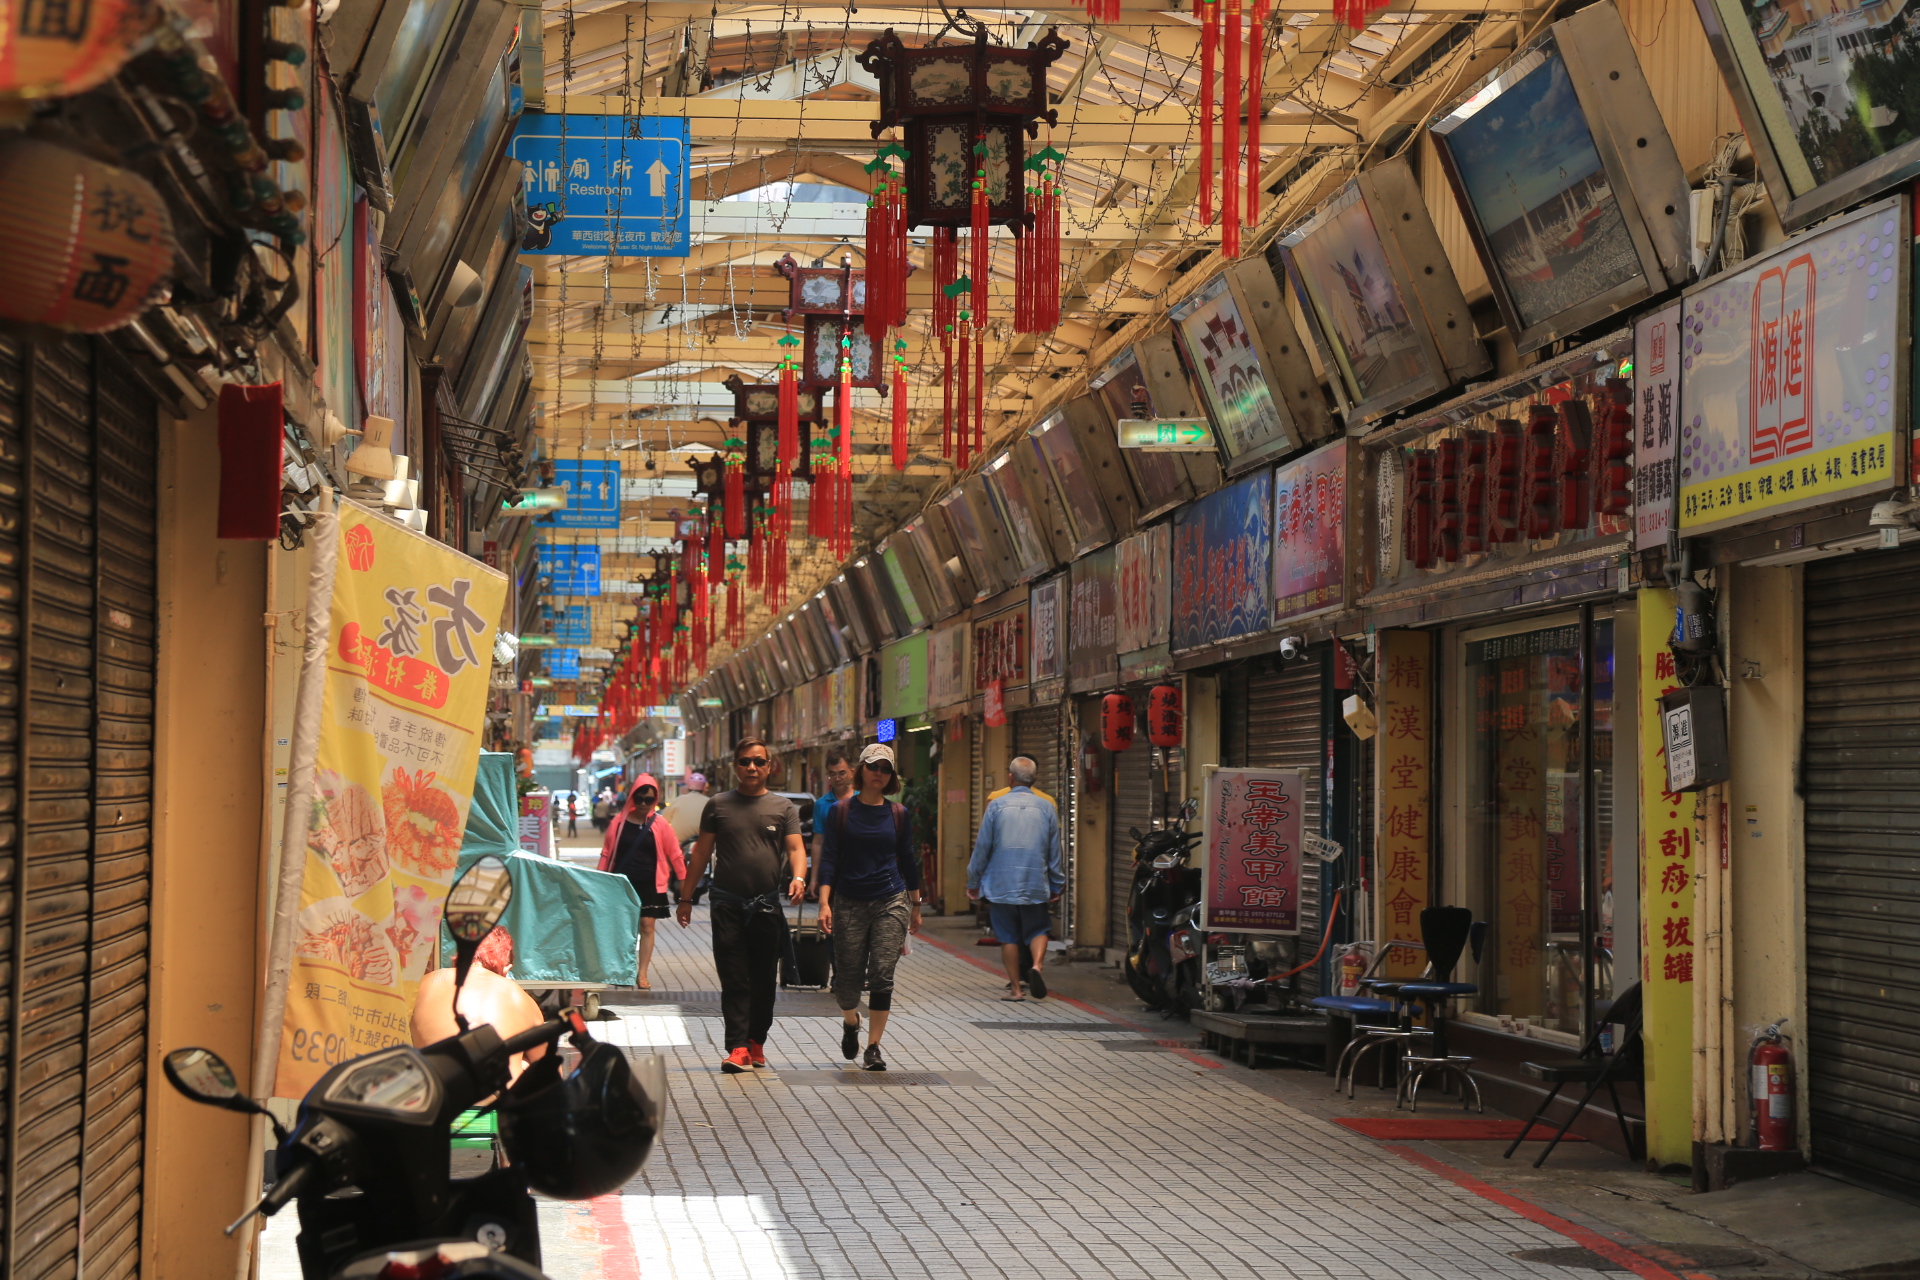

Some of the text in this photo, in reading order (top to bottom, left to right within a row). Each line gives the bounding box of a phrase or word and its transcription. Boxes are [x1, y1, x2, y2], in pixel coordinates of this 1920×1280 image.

[568, 158, 634, 180] 廁所
[569, 183, 632, 196] Restroom
[638, 244, 653, 252] Night
[1760, 308, 1803, 408] 進源
[1238, 779, 1290, 908] 玉幸美甲館
